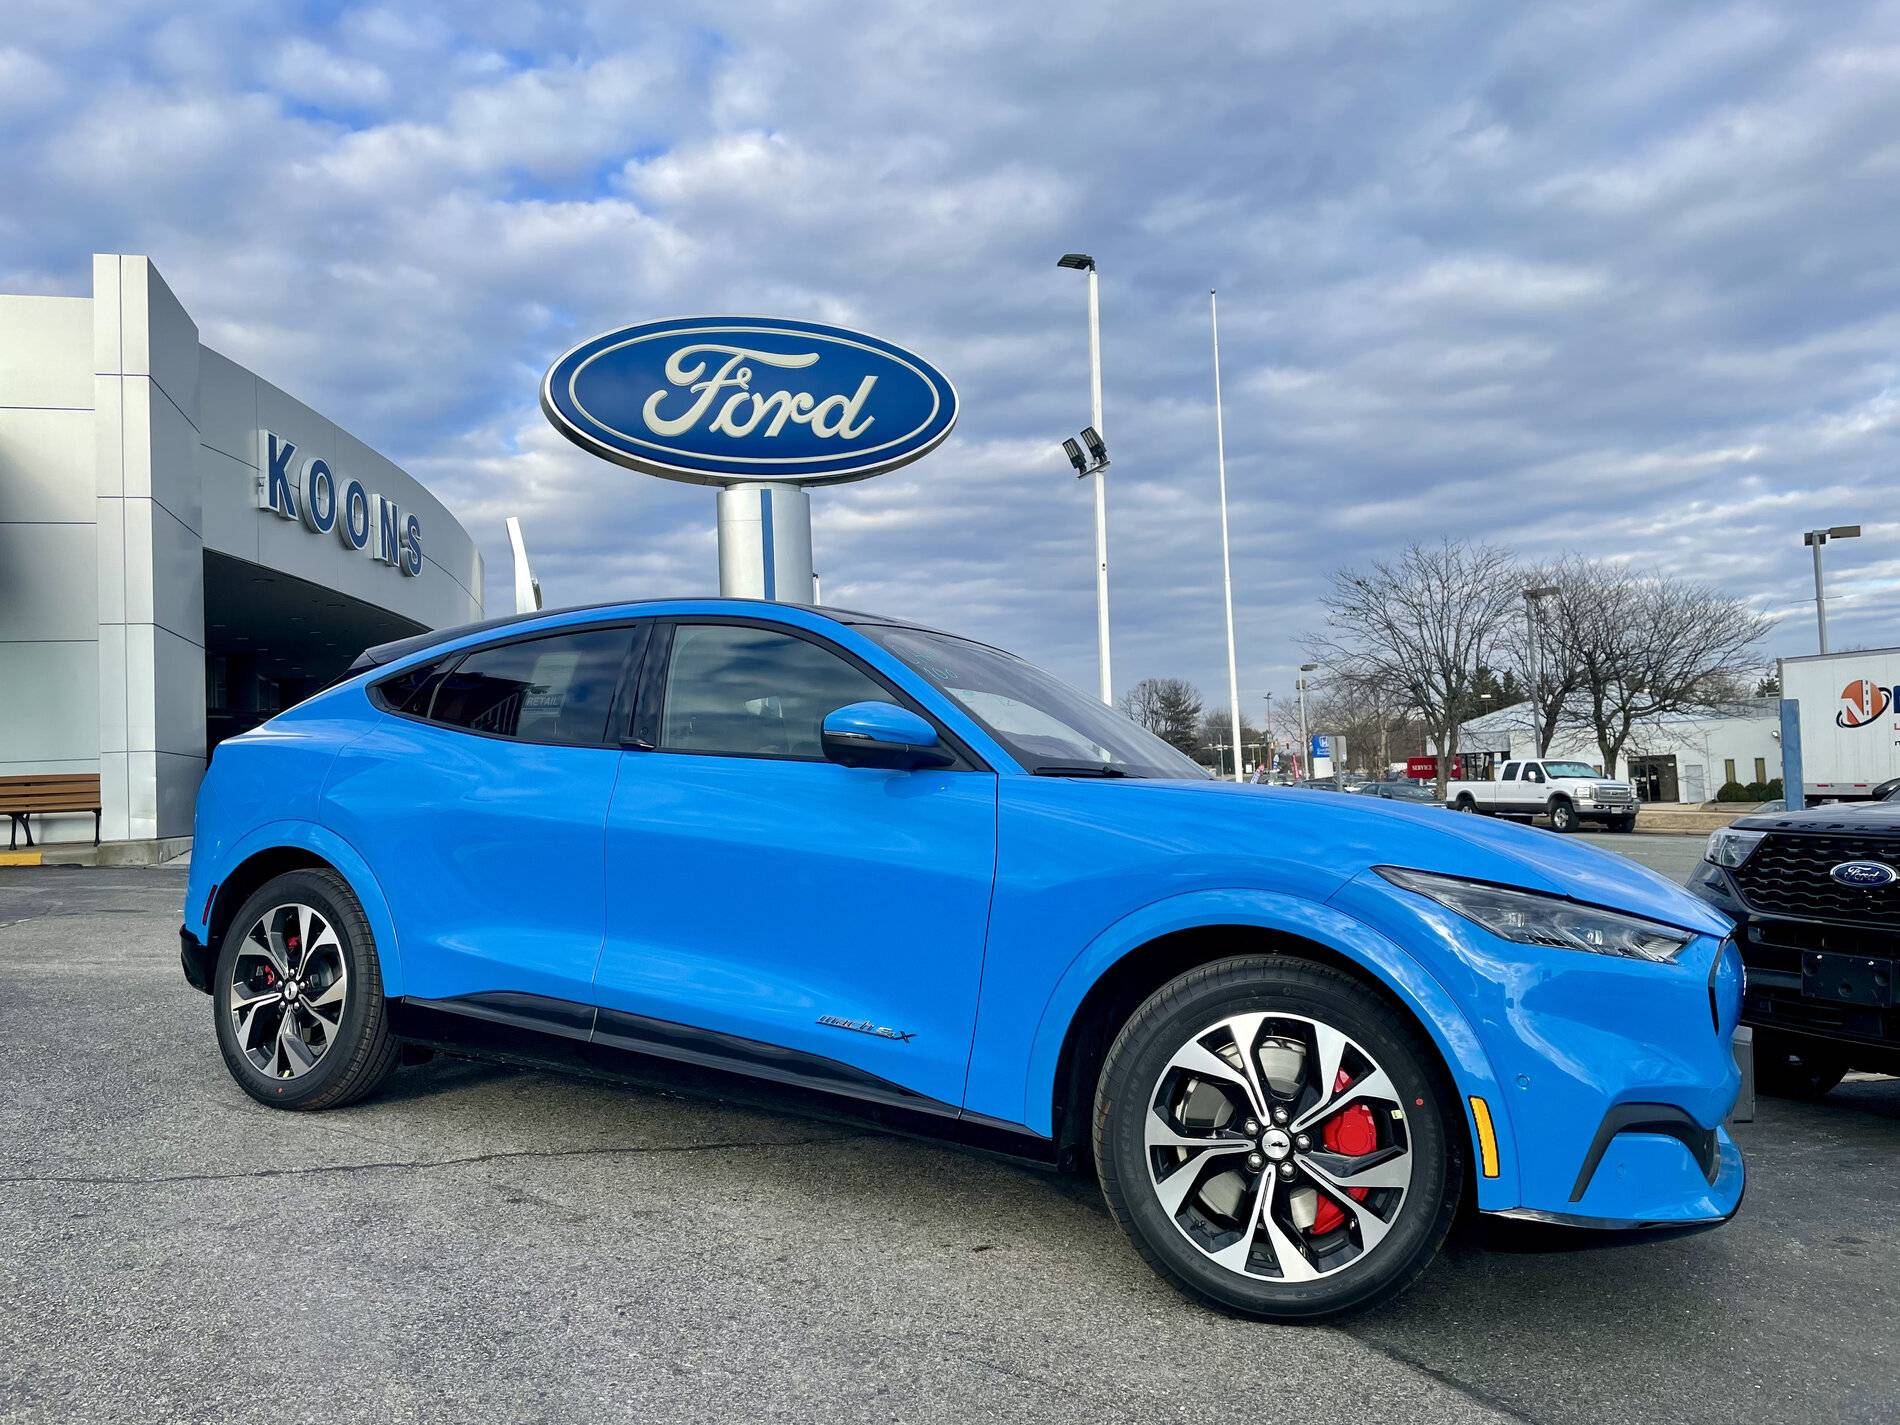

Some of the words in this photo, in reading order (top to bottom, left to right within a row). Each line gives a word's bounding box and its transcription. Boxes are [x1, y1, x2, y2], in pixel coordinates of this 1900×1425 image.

[643, 344, 879, 440] Ford
[259, 429, 424, 577] KOONS
[526, 696, 558, 706] RETAIL
[1844, 866, 1880, 881] Ford
